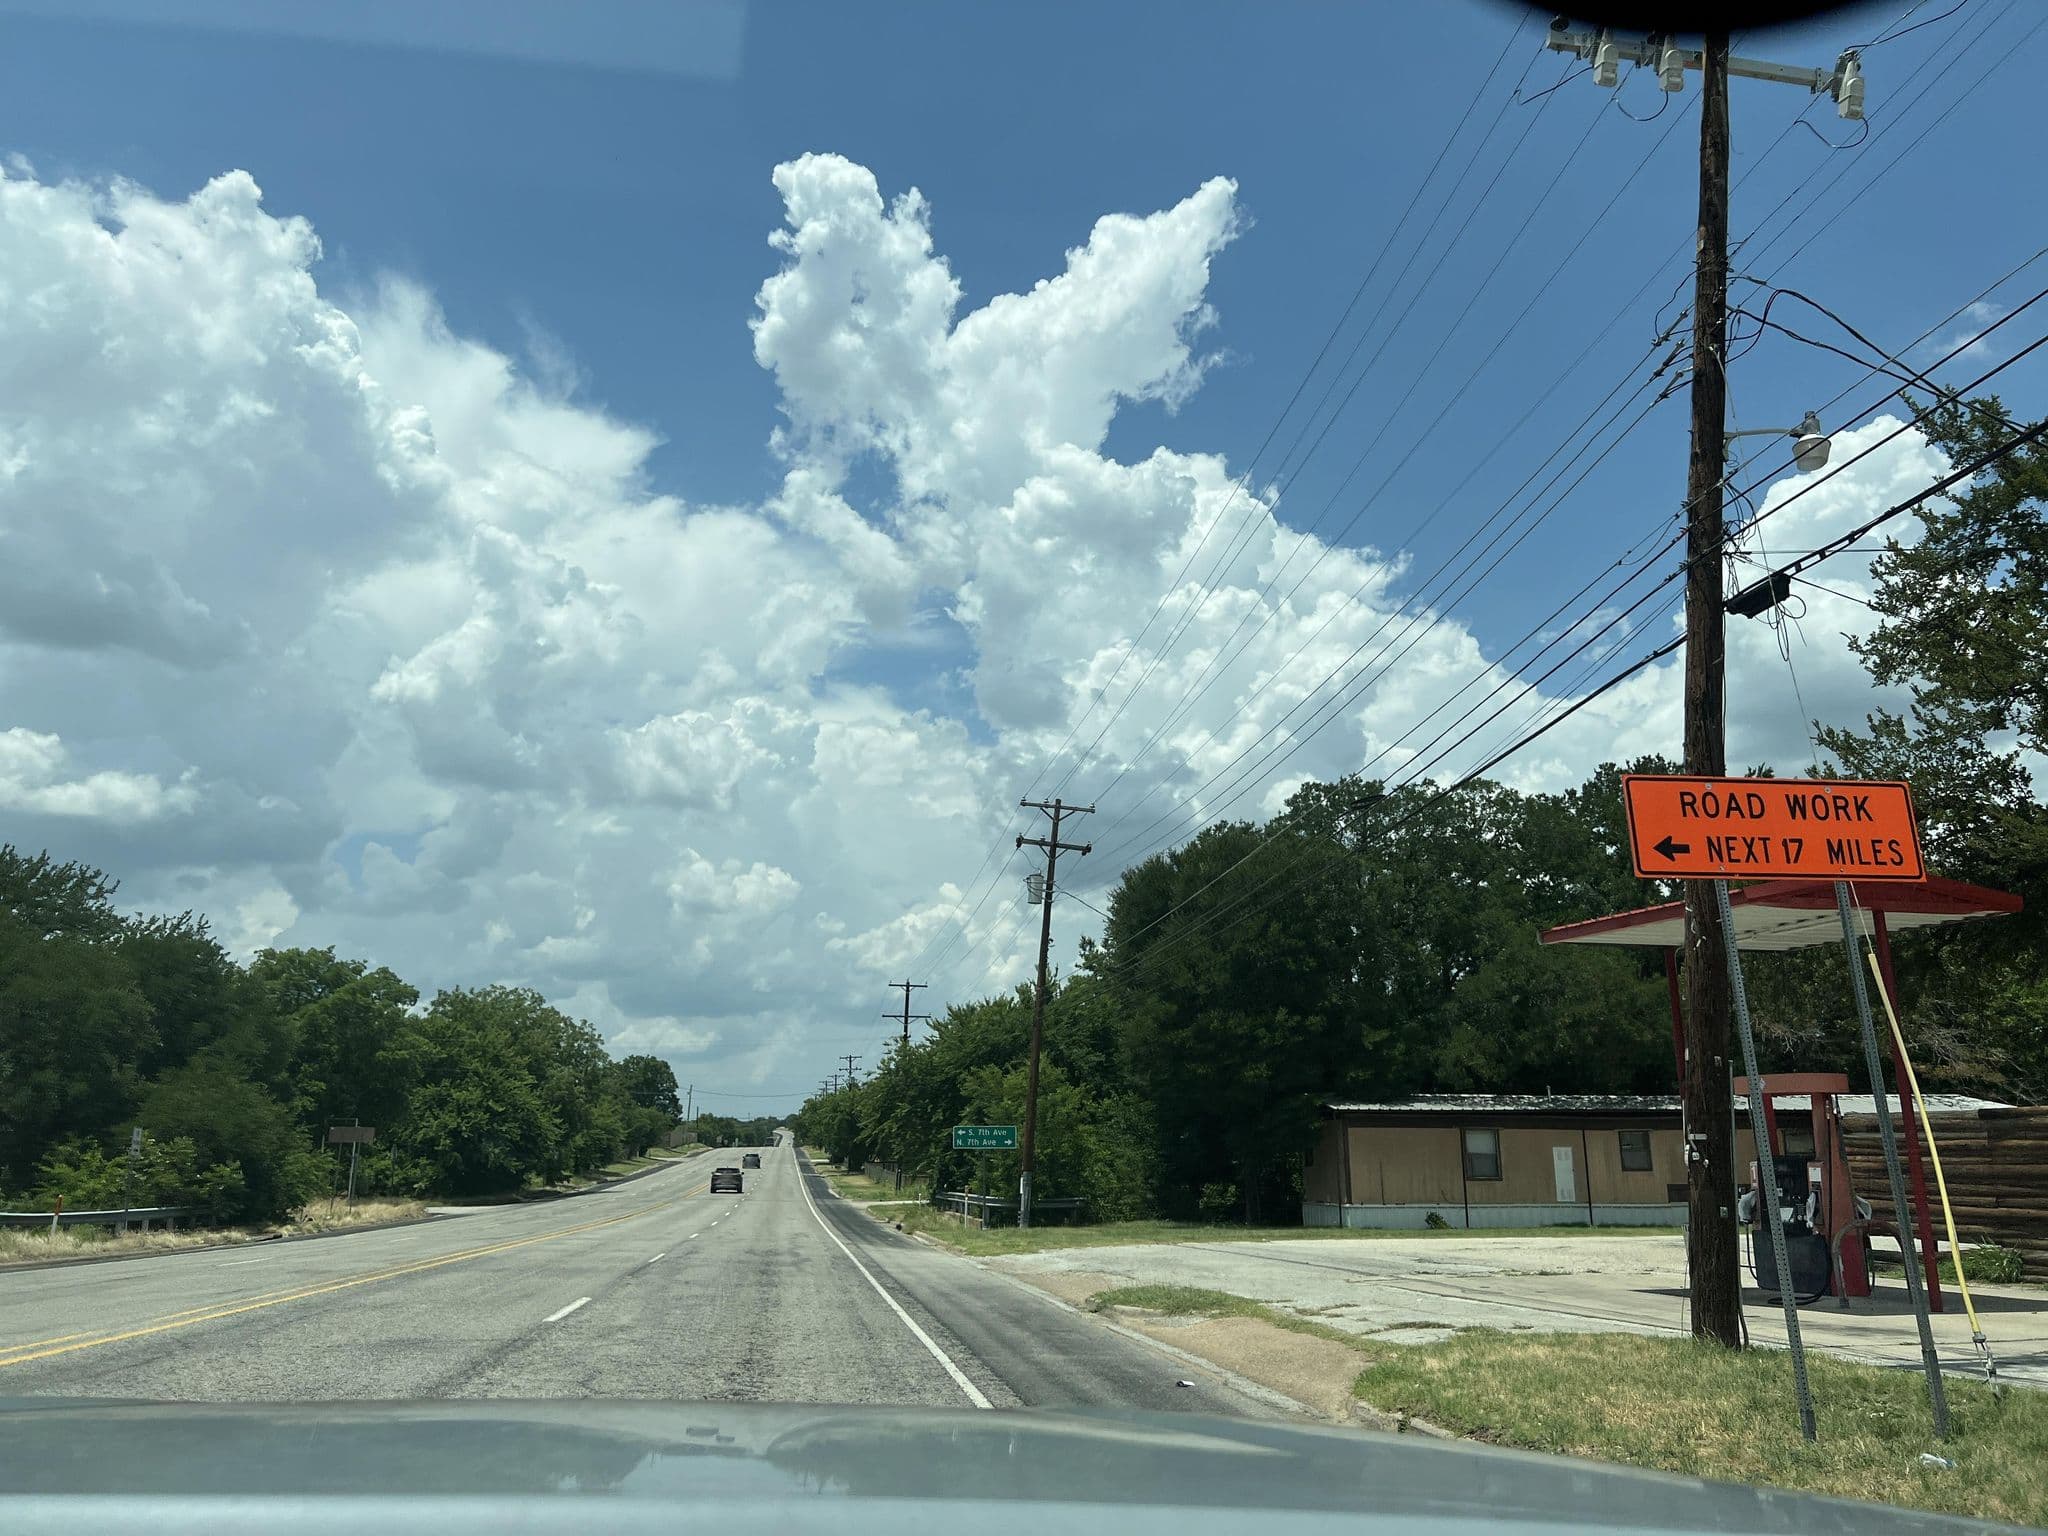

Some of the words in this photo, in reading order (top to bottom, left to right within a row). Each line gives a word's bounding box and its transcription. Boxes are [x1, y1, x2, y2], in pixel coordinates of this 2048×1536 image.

[1679, 791, 1765, 819] ROAD
[1785, 793, 1874, 822] WORK
[1706, 836, 1772, 864] NEXT
[1782, 838, 1804, 864] 17
[1826, 838, 1905, 866] MILES
[978, 1128, 990, 1136] 7th
[993, 1128, 1007, 1136] Ave
